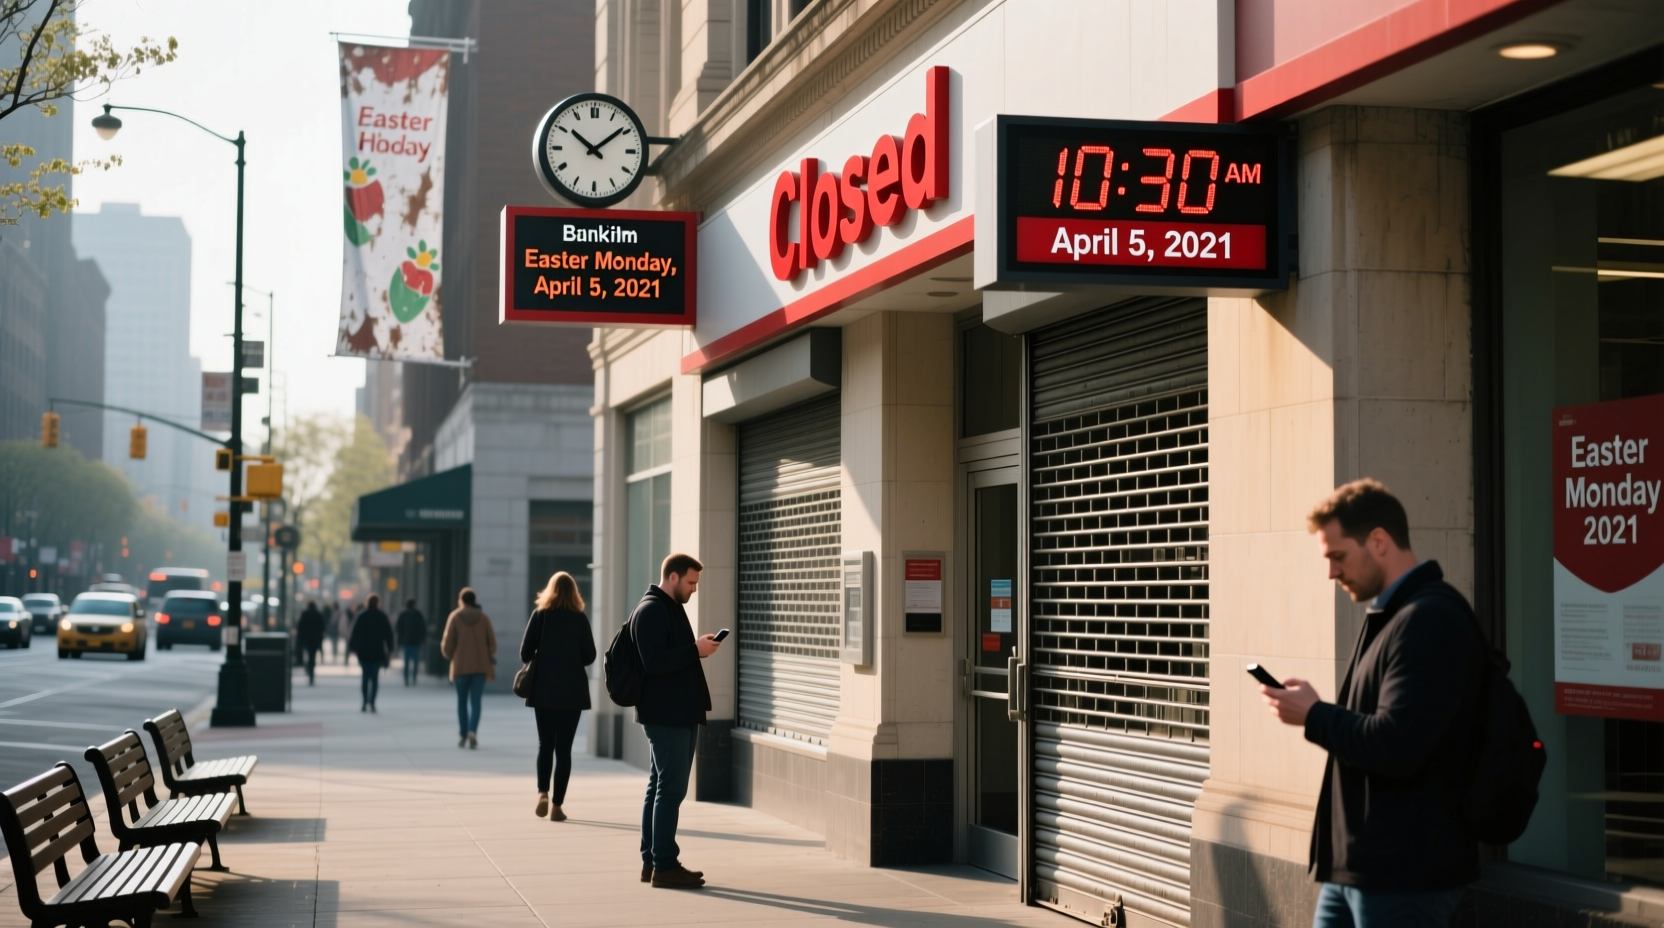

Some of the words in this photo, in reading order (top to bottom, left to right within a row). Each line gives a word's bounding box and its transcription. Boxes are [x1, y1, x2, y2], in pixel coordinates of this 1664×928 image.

[357, 105, 433, 132] Easter
[769, 65, 950, 281] Closed
[1053, 144, 1220, 214] 10:30
[1224, 162, 1262, 184] AM
[1050, 226, 1119, 261] April
[1128, 229, 1155, 262] 5,
[1163, 230, 1233, 259] 2021
[524, 249, 589, 270] Easter
[594, 250, 677, 277] Monday,
[533, 275, 582, 299] April
[588, 277, 607, 299] 5,
[613, 277, 661, 299] 2021
[1571, 434, 1649, 468] Easter
[1565, 473, 1662, 515] Monday
[1583, 514, 1638, 545] 2021
